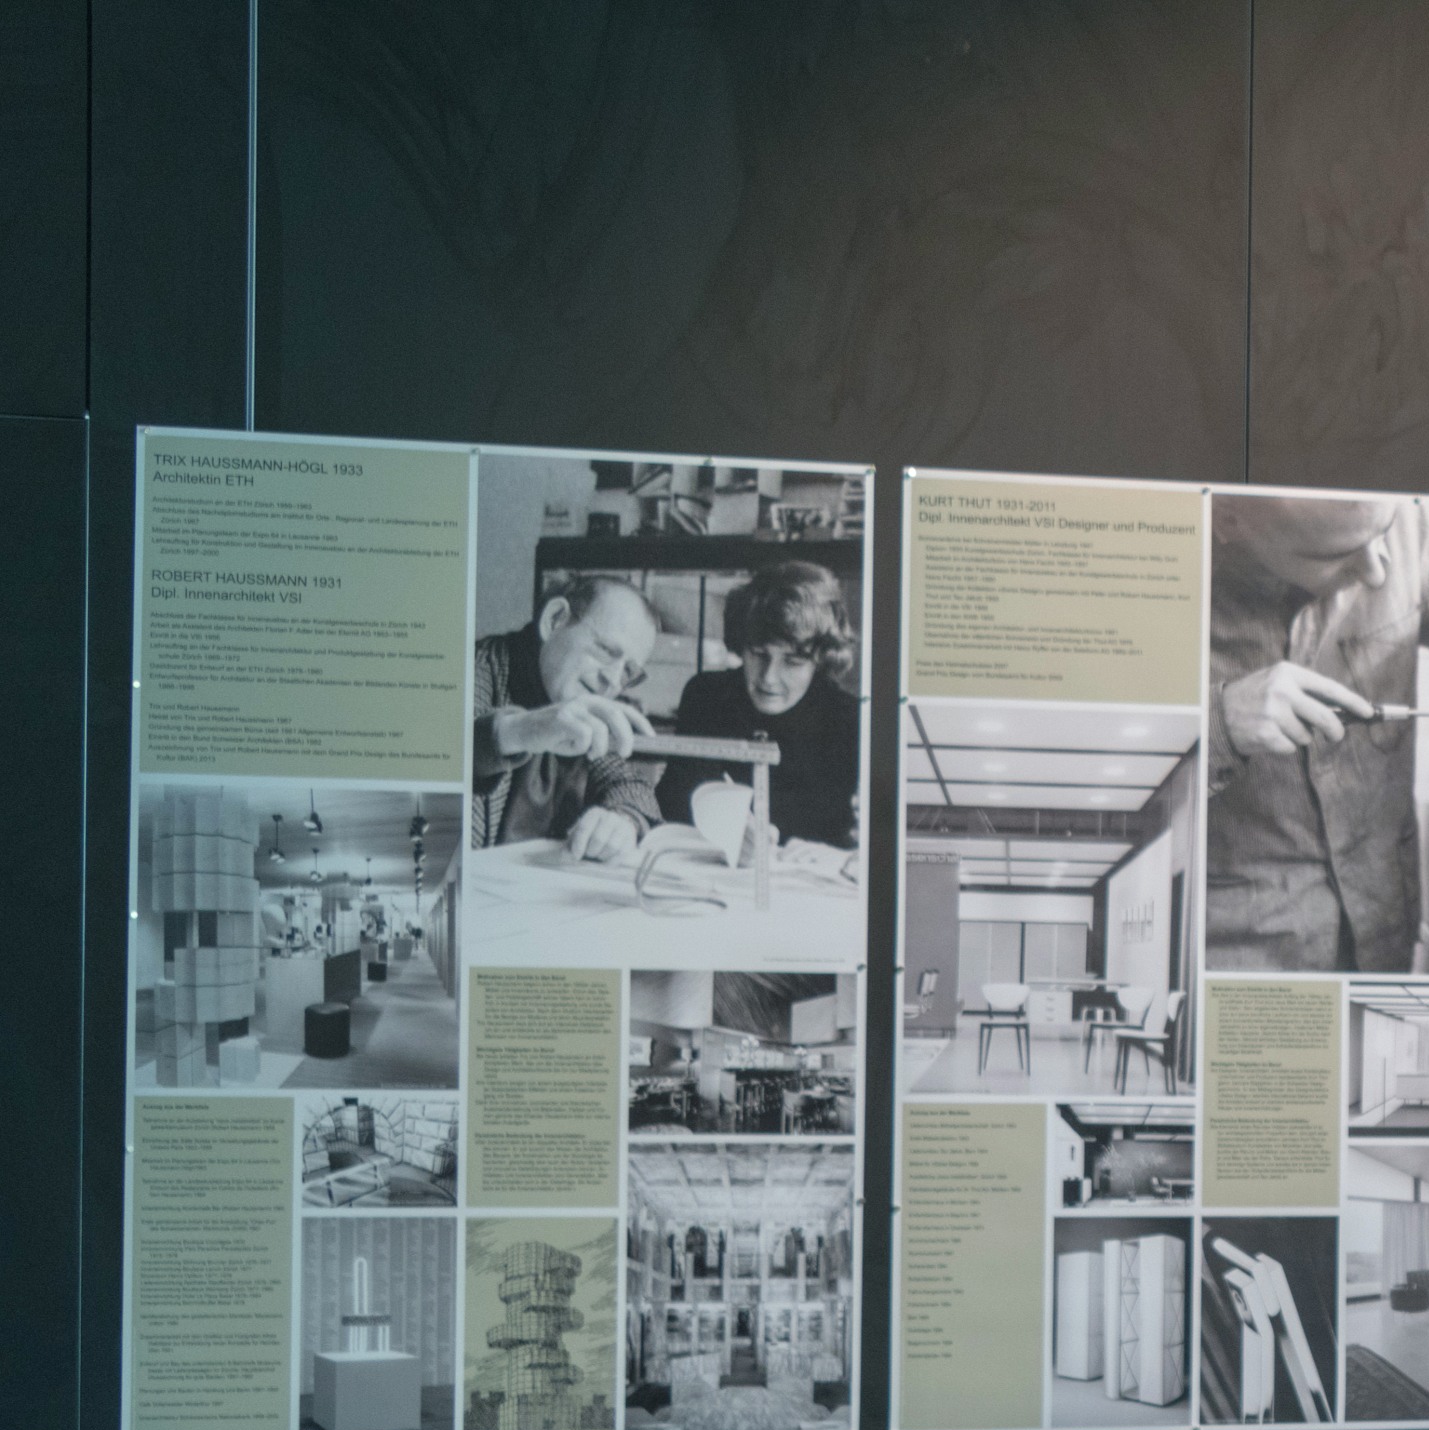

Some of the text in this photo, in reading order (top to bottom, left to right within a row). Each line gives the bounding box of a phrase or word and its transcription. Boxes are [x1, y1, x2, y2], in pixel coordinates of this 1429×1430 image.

[154, 453, 363, 476] TRIX HAUSSMANN-HÖGL 1933
[153, 471, 254, 487] Architektin ETH
[918, 495, 1056, 512] KURT THUT 1931-2011
[948, 513, 1031, 527] Innenarchitekt
[1034, 516, 1055, 528] VSI
[1058, 518, 1109, 533] Designer
[1113, 521, 1135, 532] und
[1137, 521, 1196, 535] Produzent
[151, 569, 342, 589] ROBERT HAUSSMANN 1931
[184, 588, 275, 602] Innenarchitekt
[279, 591, 302, 604] VSI
